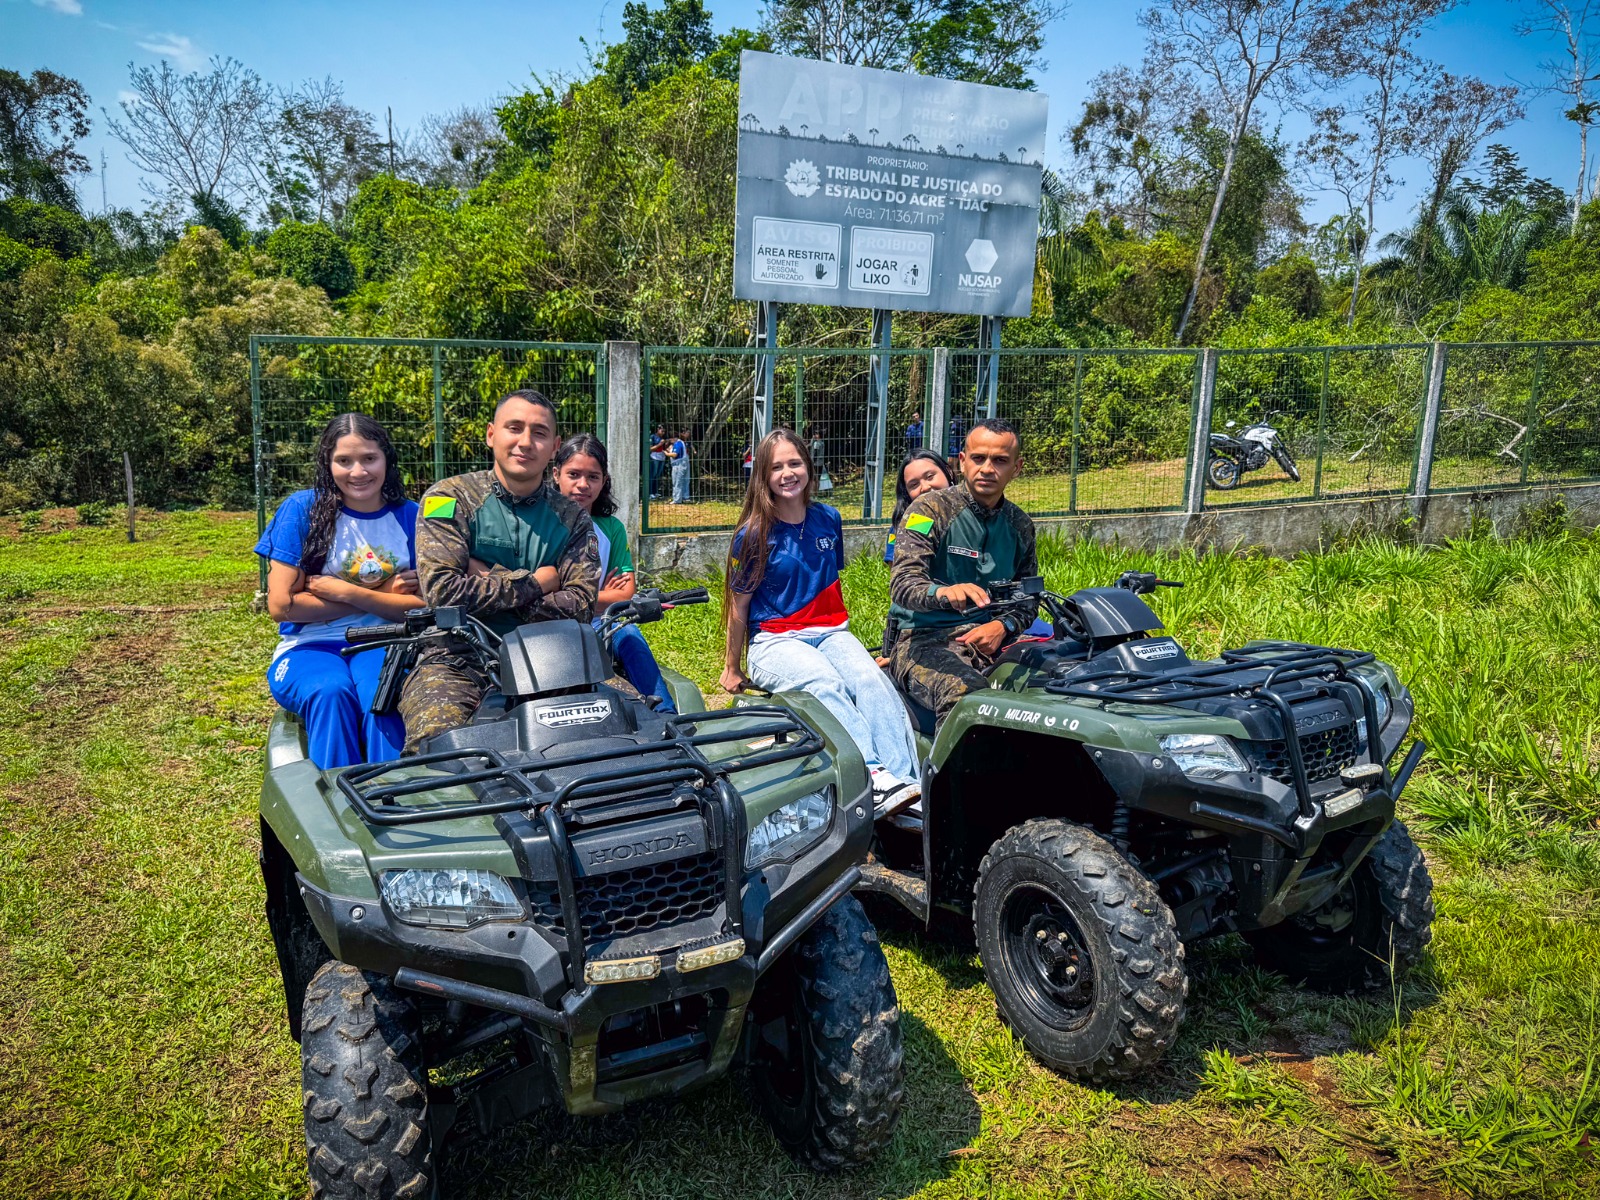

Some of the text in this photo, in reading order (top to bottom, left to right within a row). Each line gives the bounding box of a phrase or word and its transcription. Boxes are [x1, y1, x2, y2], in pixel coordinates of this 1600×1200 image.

[779, 71, 903, 130] APP
[867, 155, 929, 171] PROPRIETÁRIO:
[825, 165, 1003, 197] TRIBUNAL DE JUSTIÇA DO
[825, 183, 882, 202] ESTADO
[885, 190, 906, 204] DO
[909, 192, 947, 208] ACRE
[957, 197, 989, 212] TJAC
[844, 202, 944, 225] Área: 71.136,71 m²
[763, 224, 832, 245] AVISO
[856, 235, 928, 252] PROIBIDO
[757, 245, 836, 262] ÁREA RESTRITA
[766, 258, 799, 267] SOMENTE
[767, 266, 798, 274] PESSOAL
[856, 258, 898, 271] JOGAR
[760, 272, 804, 281] AUTORIZADO
[863, 273, 890, 285] LIXO
[958, 274, 1002, 289] NUSAP
[1135, 645, 1177, 656] FOURTRAX
[538, 705, 609, 720] FOURTRAX
[587, 831, 697, 867] HONDA
